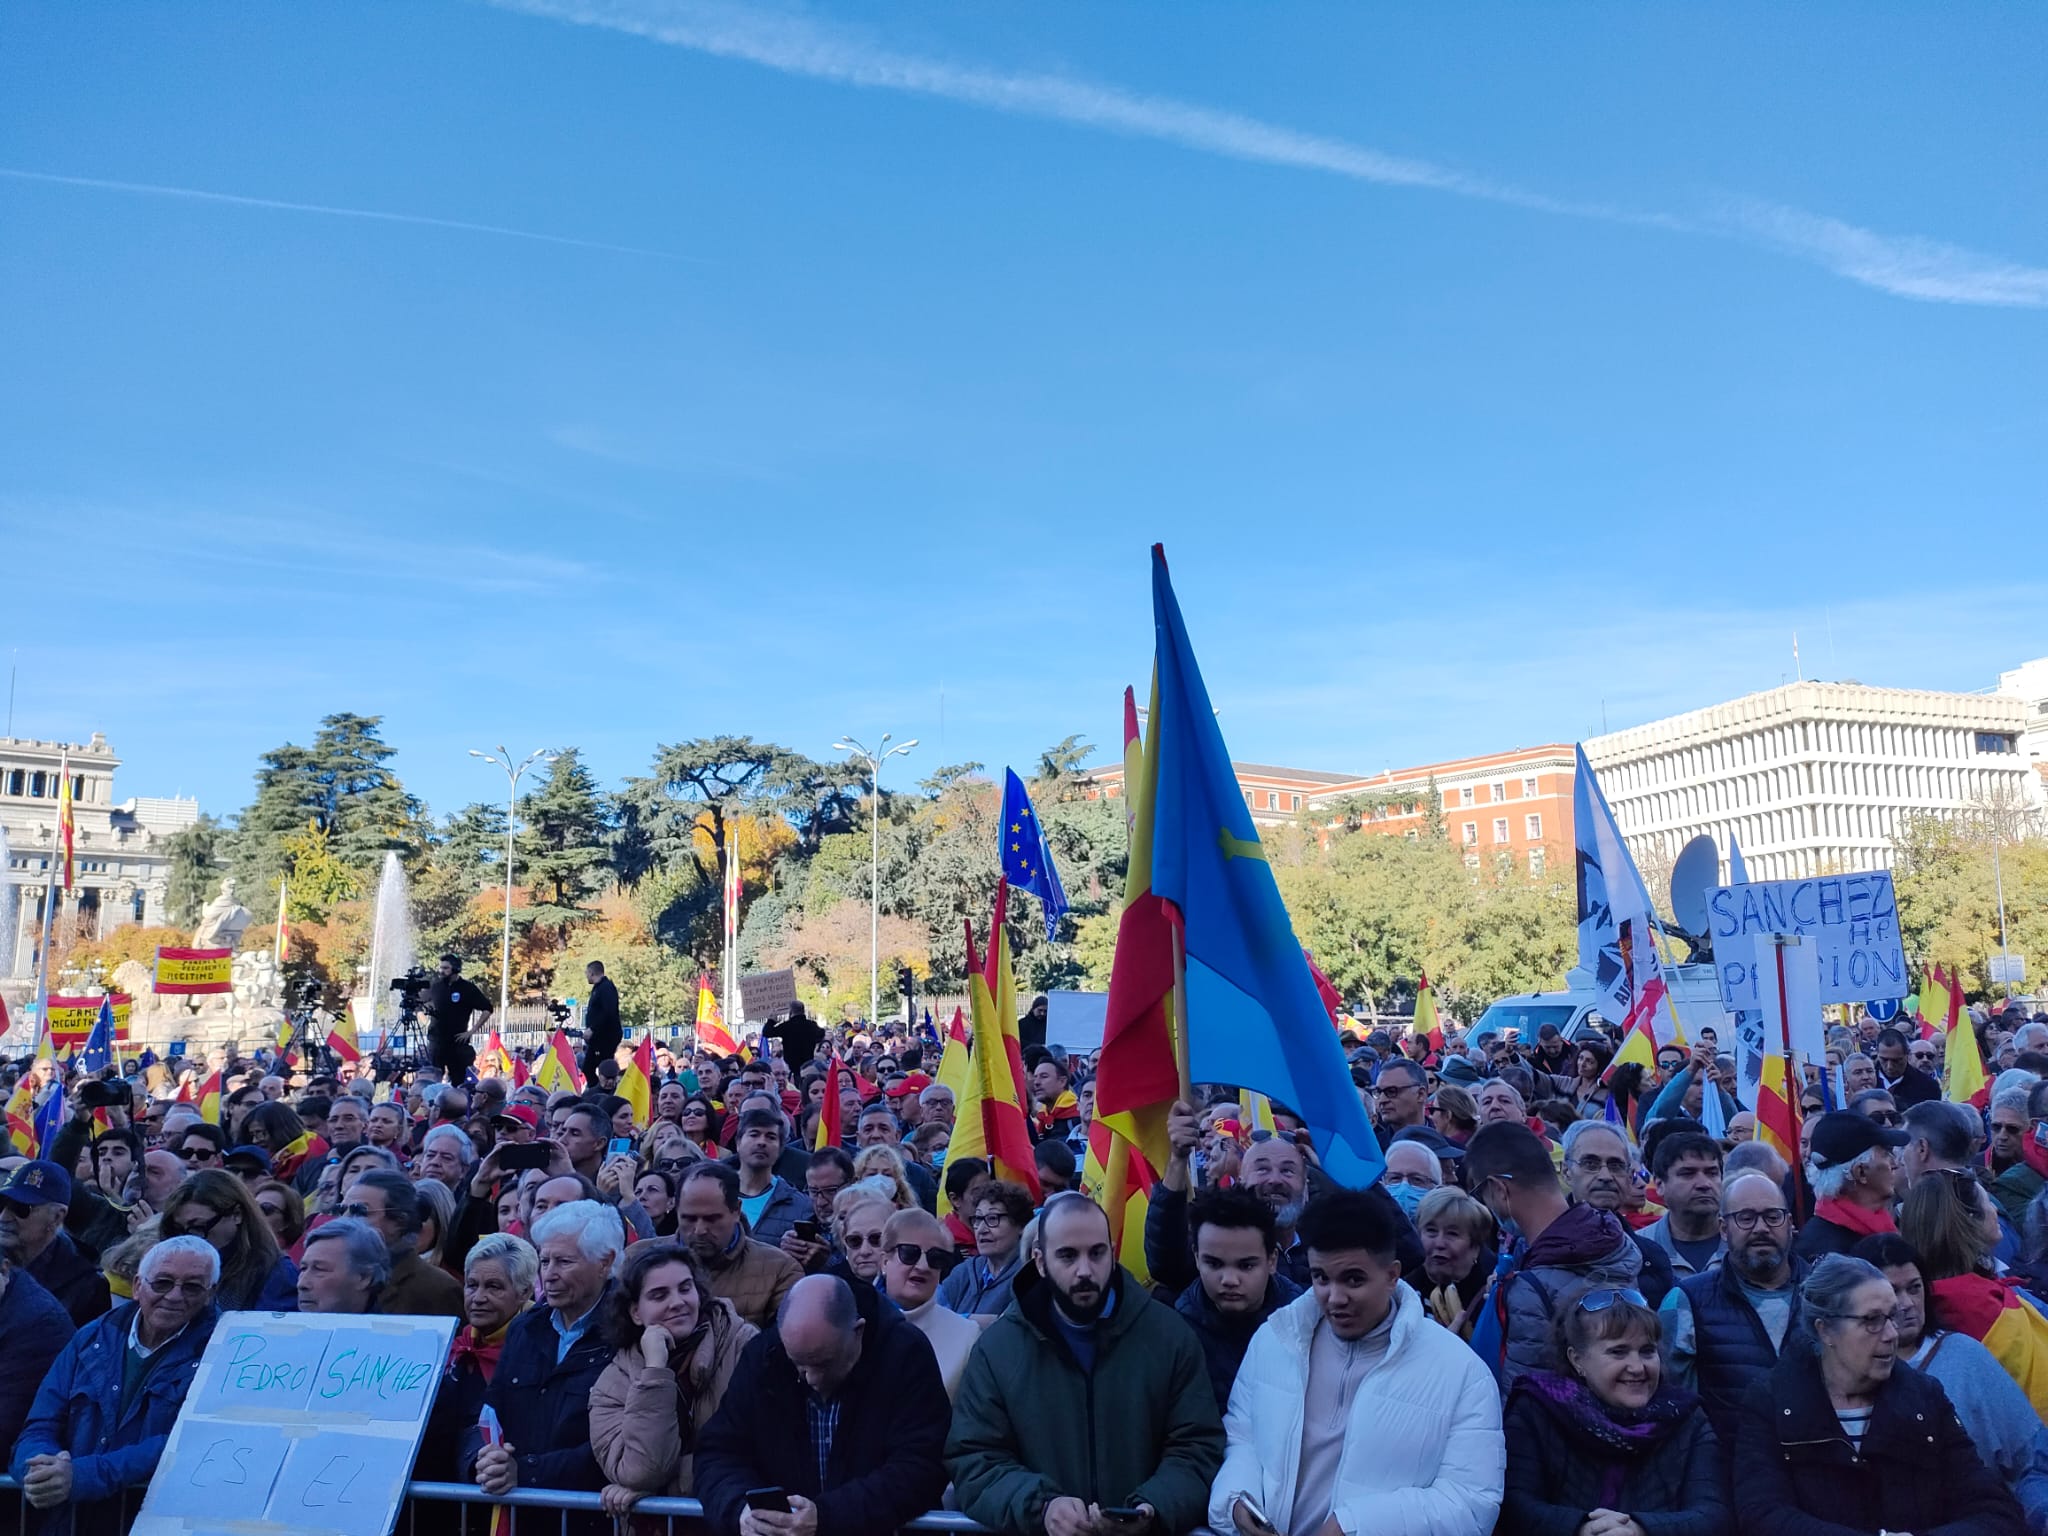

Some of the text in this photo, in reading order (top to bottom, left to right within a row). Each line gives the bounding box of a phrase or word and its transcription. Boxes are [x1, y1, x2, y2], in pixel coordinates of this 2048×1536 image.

[1711, 875, 1894, 937] SANCHEZ
[221, 1333, 432, 1399] PEDRO SANCHEZ
[190, 1438, 365, 1507] ES EL
